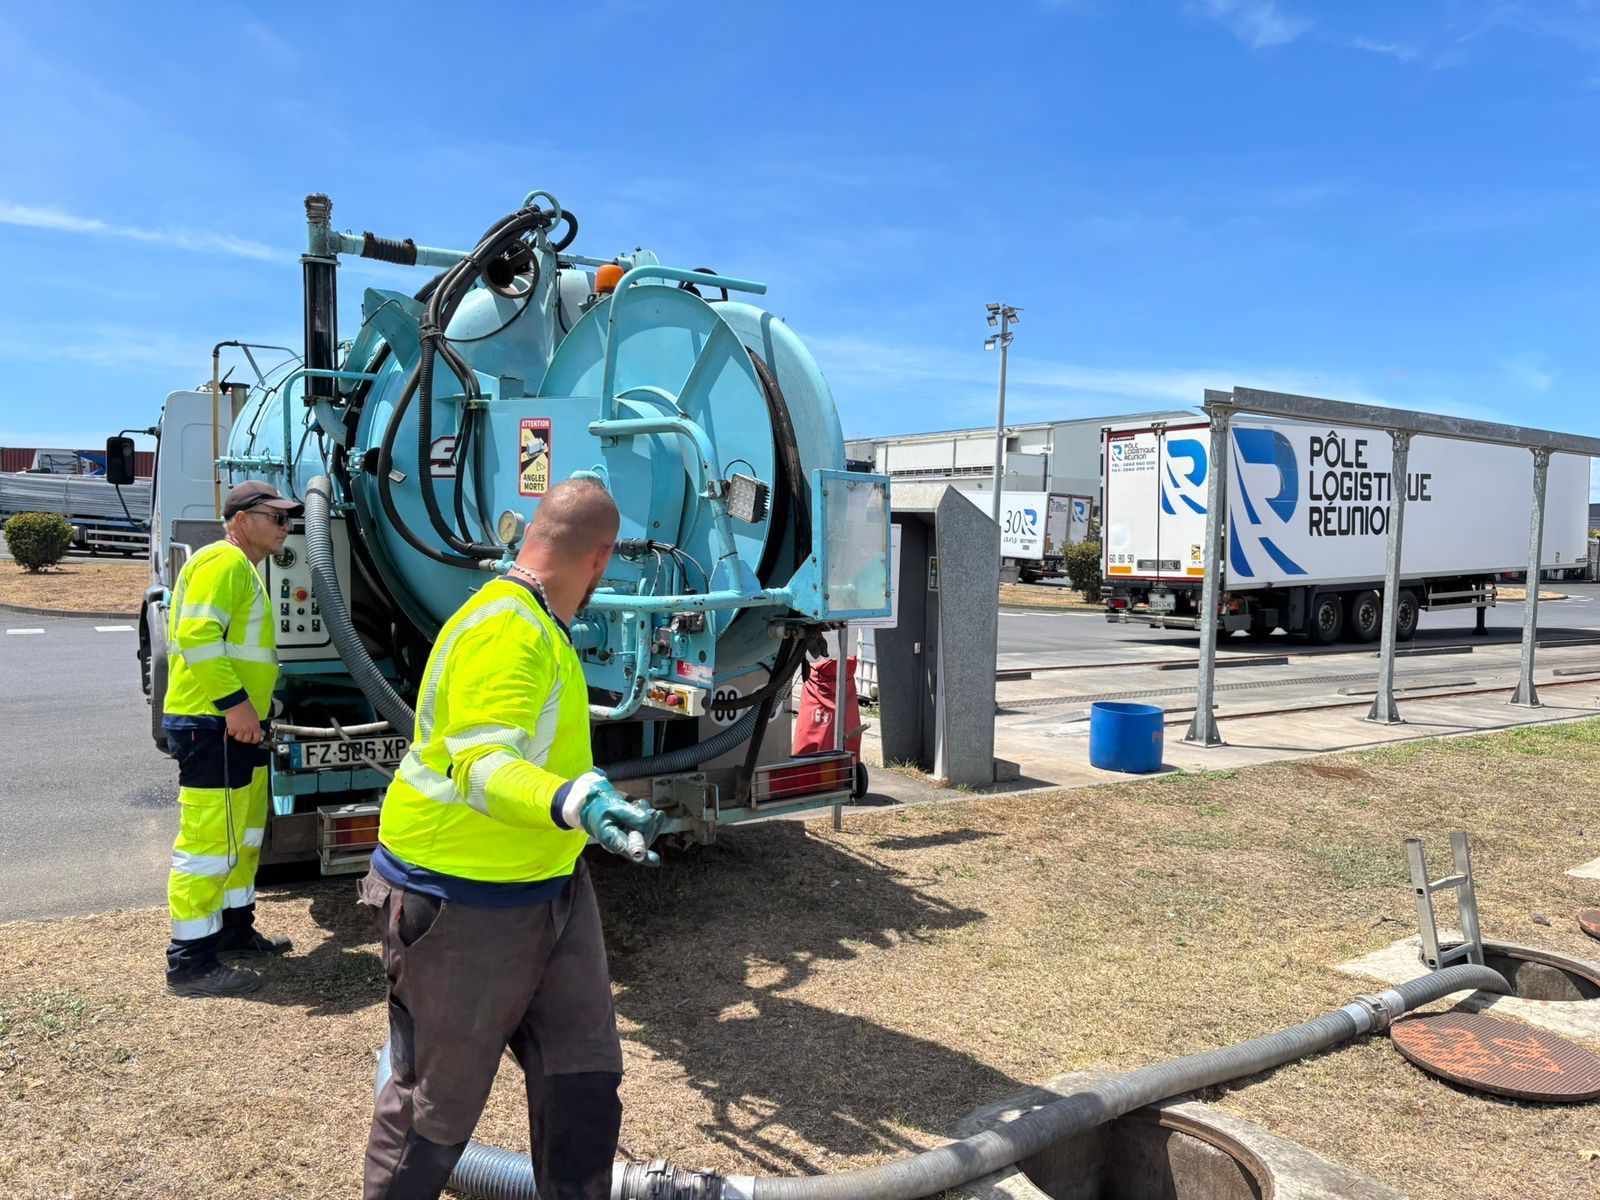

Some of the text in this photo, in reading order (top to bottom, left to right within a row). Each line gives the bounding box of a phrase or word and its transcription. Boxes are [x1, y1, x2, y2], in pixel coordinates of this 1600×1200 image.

[521, 420, 549, 428] ATTENTION
[1310, 430, 1368, 469] PÔLE
[523, 473, 546, 482] ANGLES
[524, 482, 545, 491] MORTS
[1309, 470, 1432, 502] LOGISTIUE
[1309, 502, 1390, 537] RÉUNIO
[1109, 554, 1134, 563] 60 80 90
